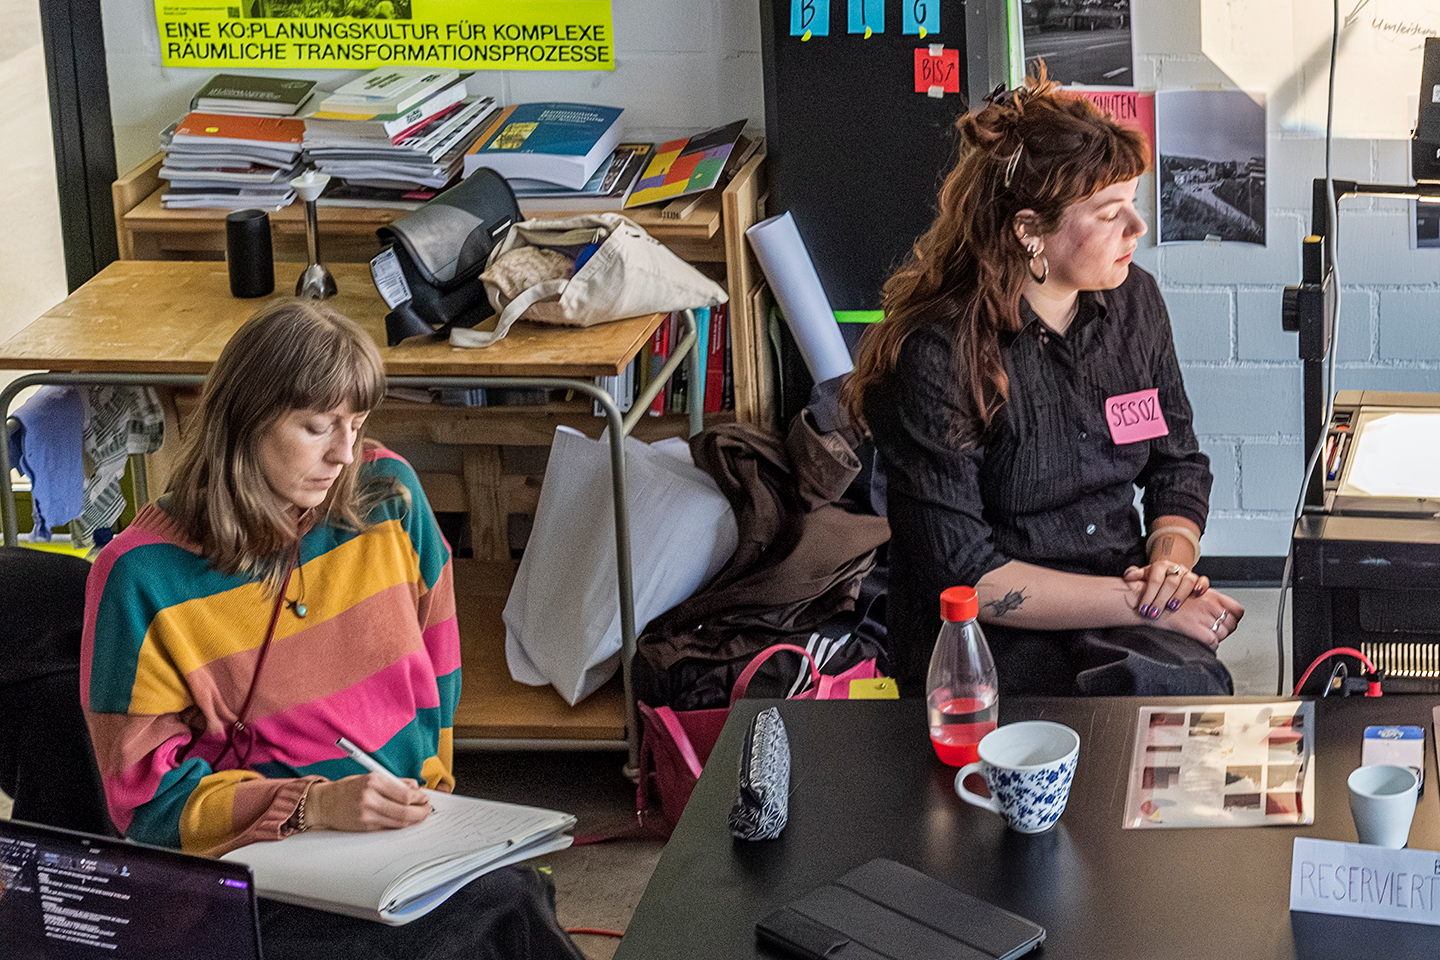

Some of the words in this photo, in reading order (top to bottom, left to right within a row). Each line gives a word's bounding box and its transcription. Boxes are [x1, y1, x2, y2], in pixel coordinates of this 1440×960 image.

[165, 21, 211, 38] EINE
[218, 21, 439, 41] KO:PLANUNGSKULTUR
[447, 19, 485, 41] FÜR
[494, 23, 606, 42] KOMPLEXE
[168, 38, 287, 60] RÄUMLICHE
[297, 43, 610, 63] TRANSFORMATIONSPROZESSE
